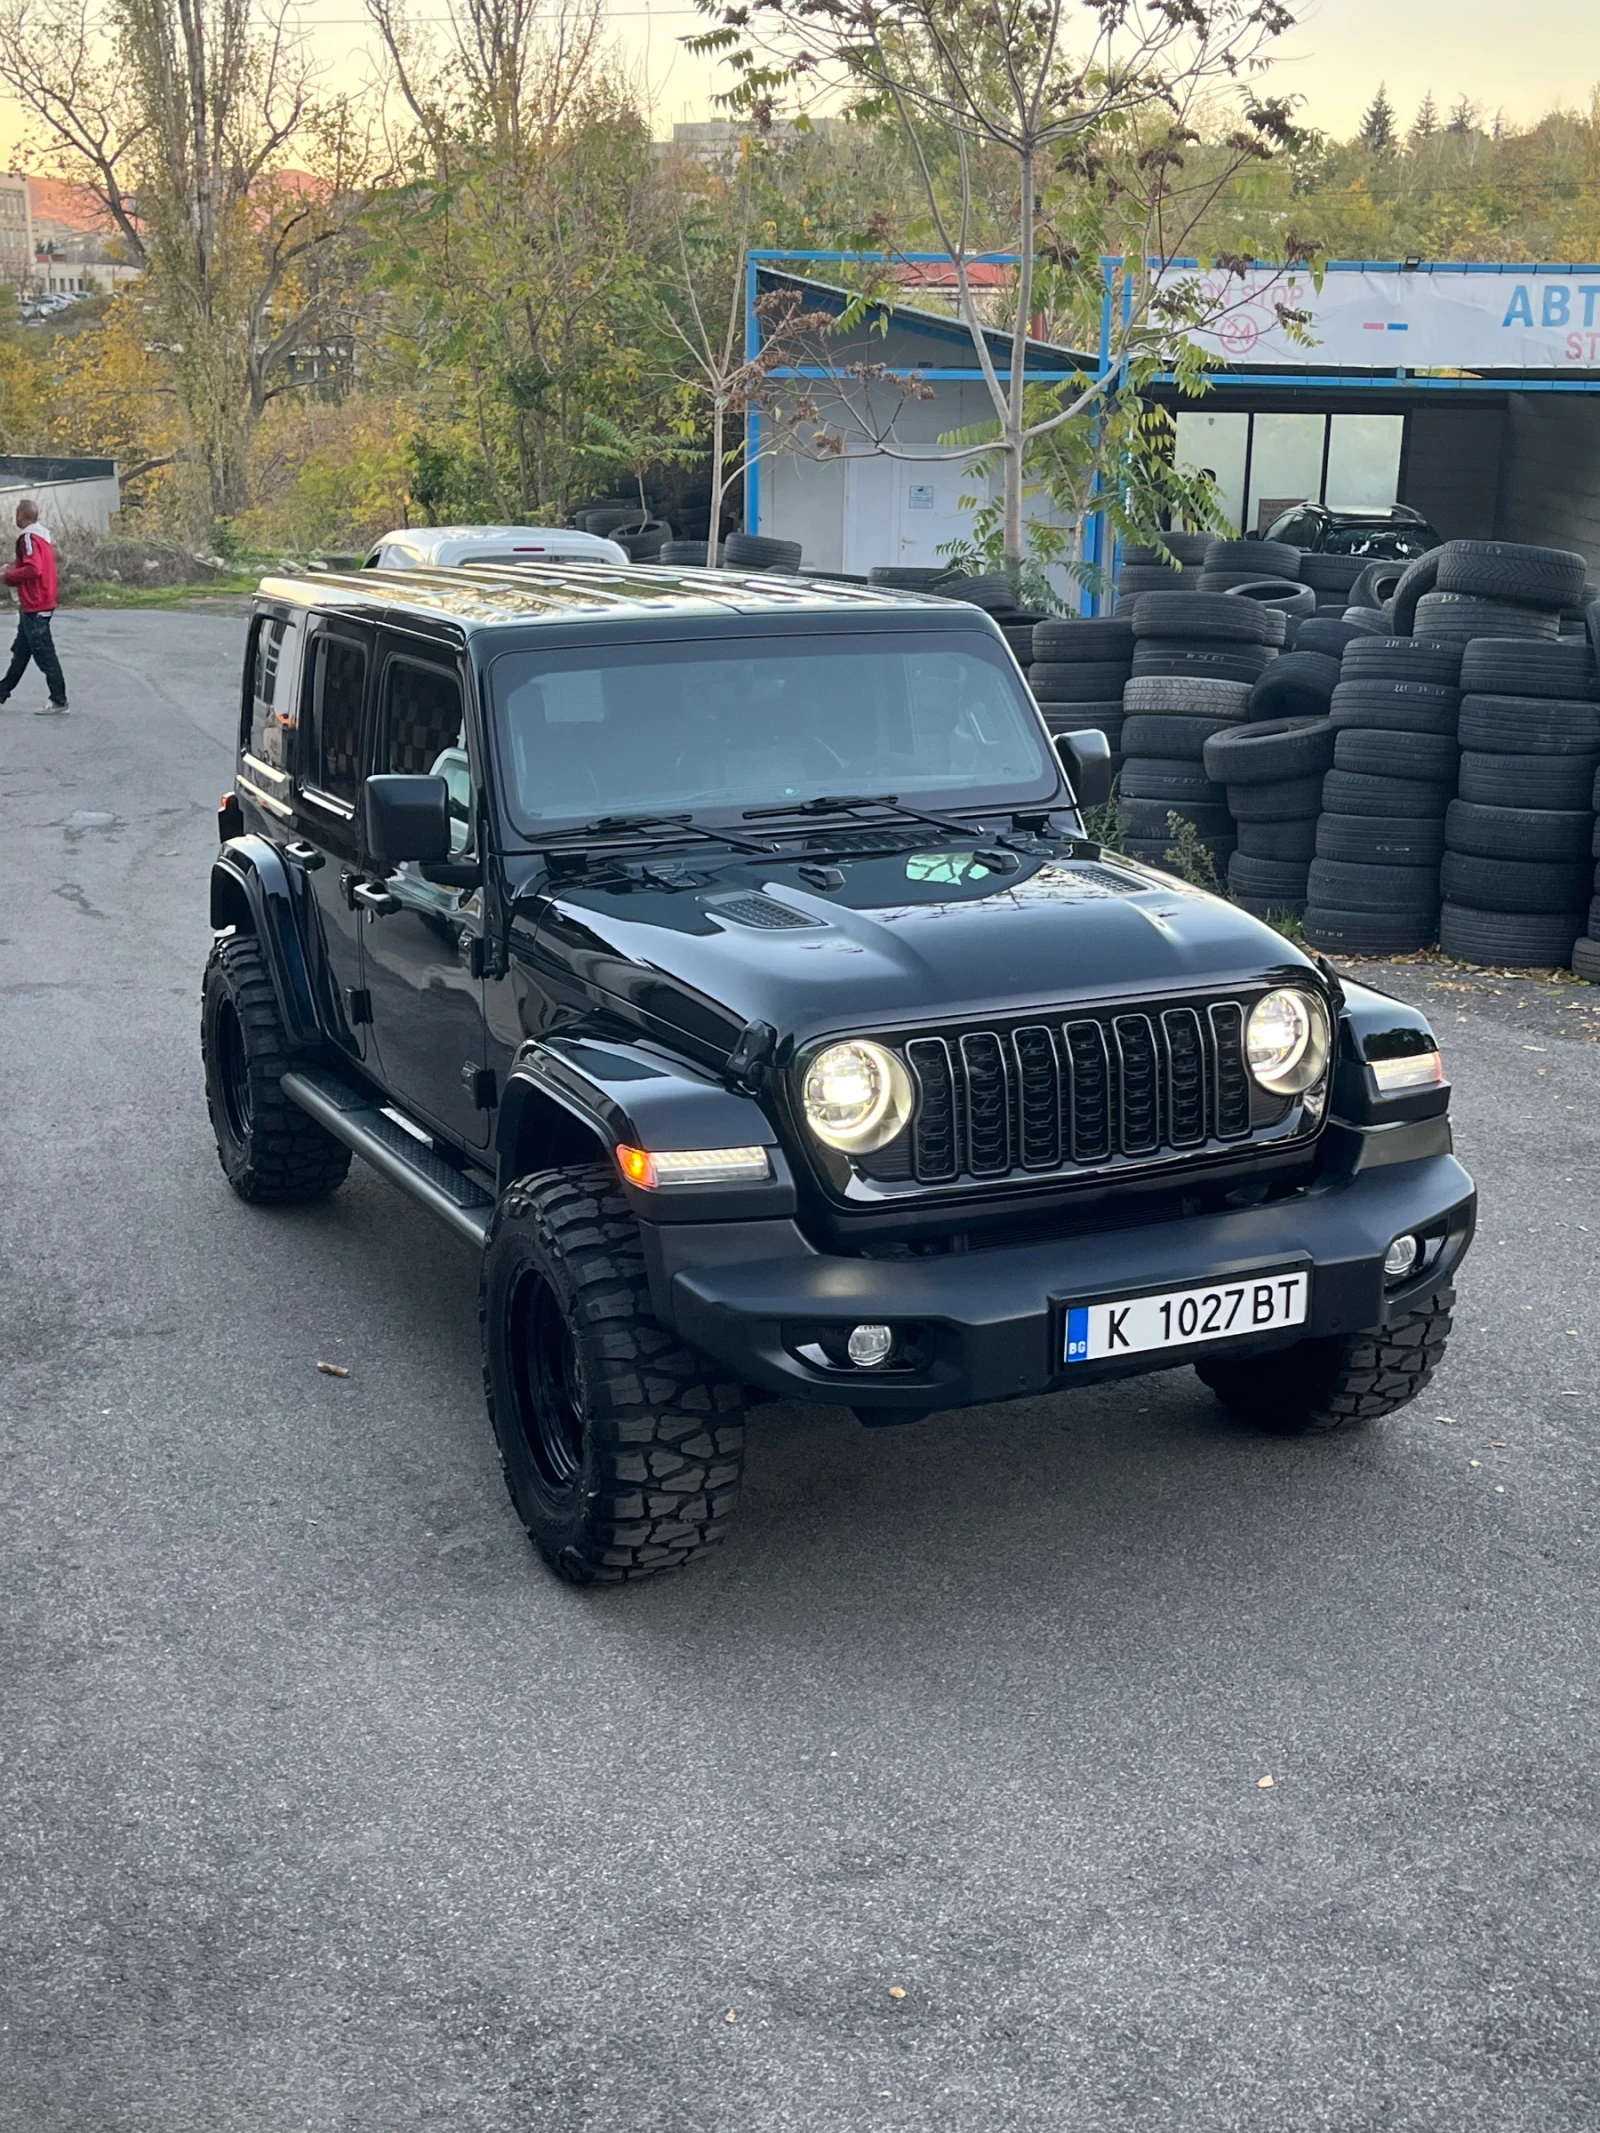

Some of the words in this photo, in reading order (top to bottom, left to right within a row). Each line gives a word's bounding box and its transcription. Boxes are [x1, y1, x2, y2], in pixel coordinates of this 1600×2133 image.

[1242, 284, 1304, 307] STOP
[1502, 285, 1600, 327] АВТ
[1225, 320, 1252, 344] 24
[1564, 331, 1600, 360] ST
[1108, 1306, 1131, 1350] K
[1159, 1288, 1245, 1341] 1027
[1252, 1279, 1300, 1325] BT
[1068, 1340, 1086, 1355] BG
